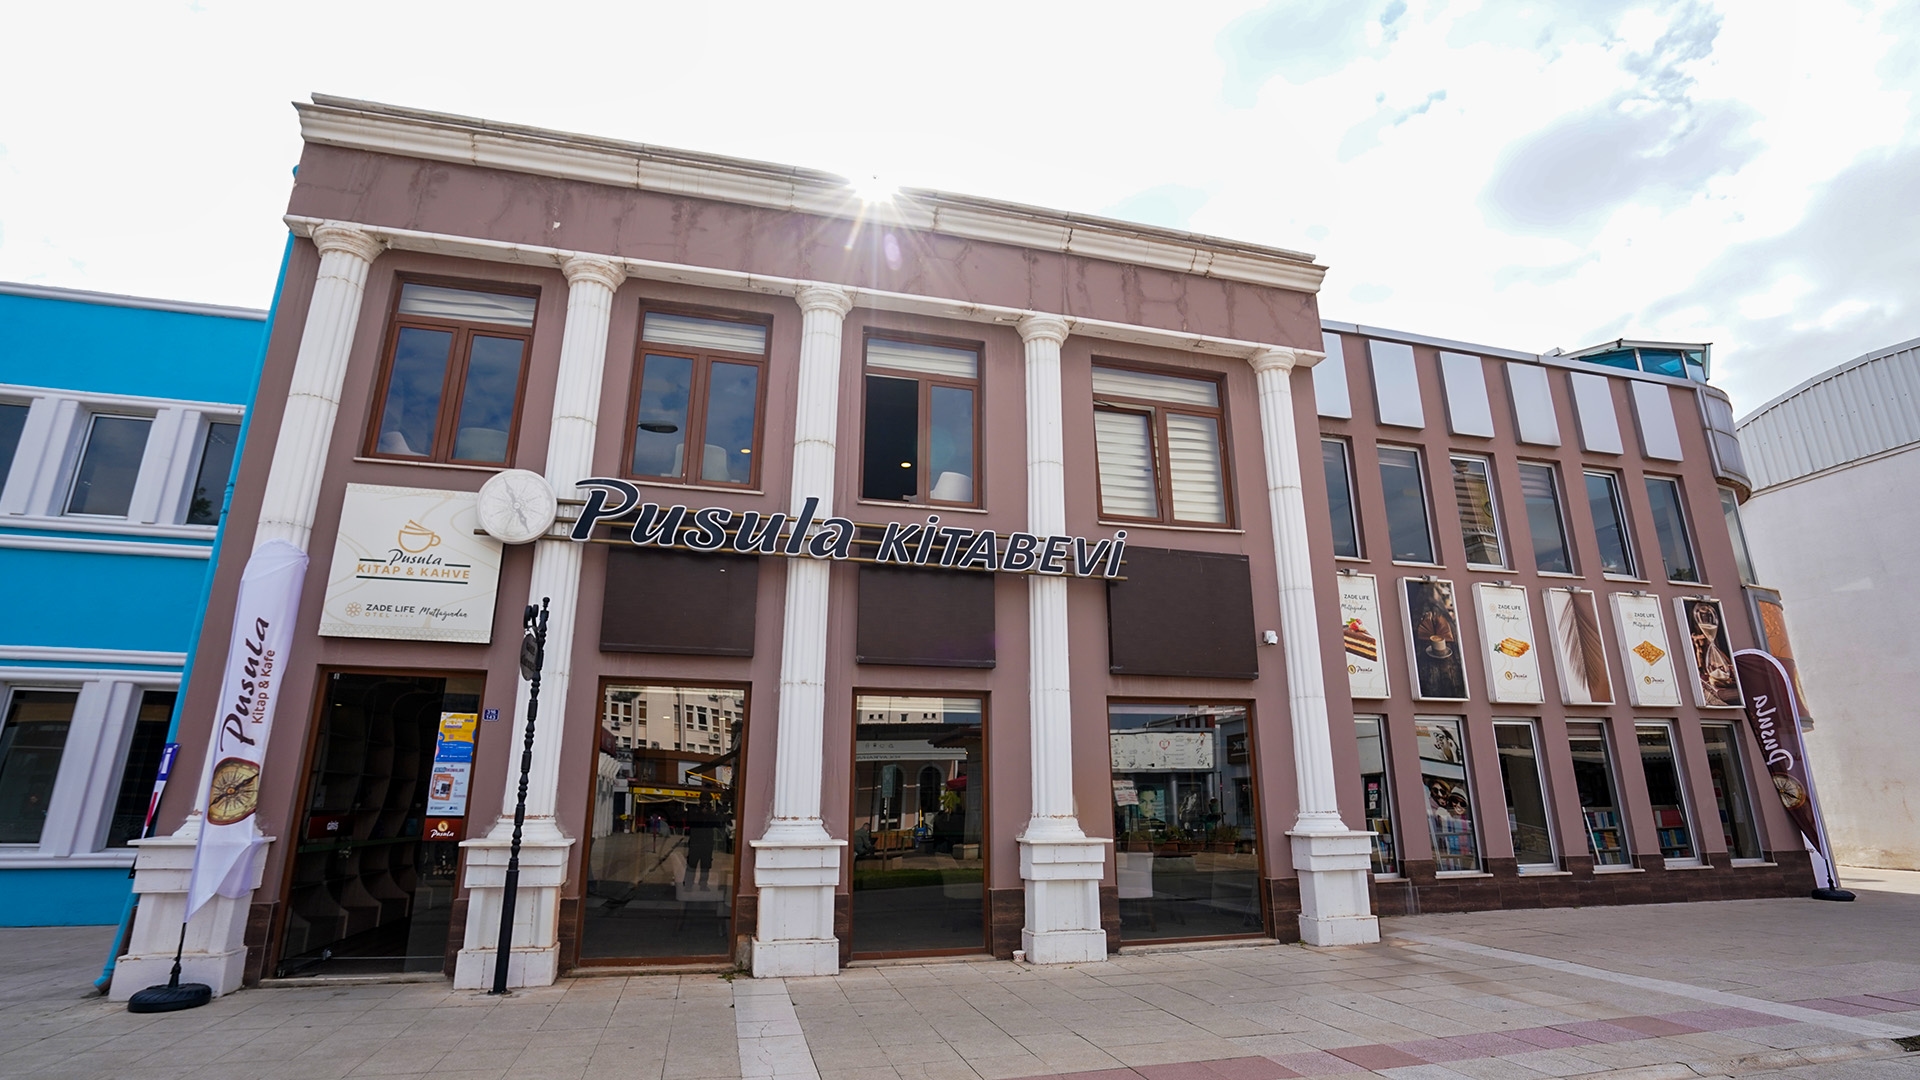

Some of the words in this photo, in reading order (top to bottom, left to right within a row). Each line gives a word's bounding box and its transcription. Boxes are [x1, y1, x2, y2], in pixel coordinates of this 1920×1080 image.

[570, 477, 855, 560] Pusula
[876, 515, 1127, 579] KİTABEVİ
[388, 548, 442, 566] Pusula
[357, 564, 401, 575] KİTAP
[406, 566, 414, 576] &
[420, 568, 470, 579] KAHVE
[366, 604, 393, 612] ZADE
[395, 605, 415, 613] LIFE
[261, 649, 275, 677] Kafe
[220, 617, 269, 752] Pusula
[258, 680, 269, 689] &
[252, 691, 269, 724] Kitap
